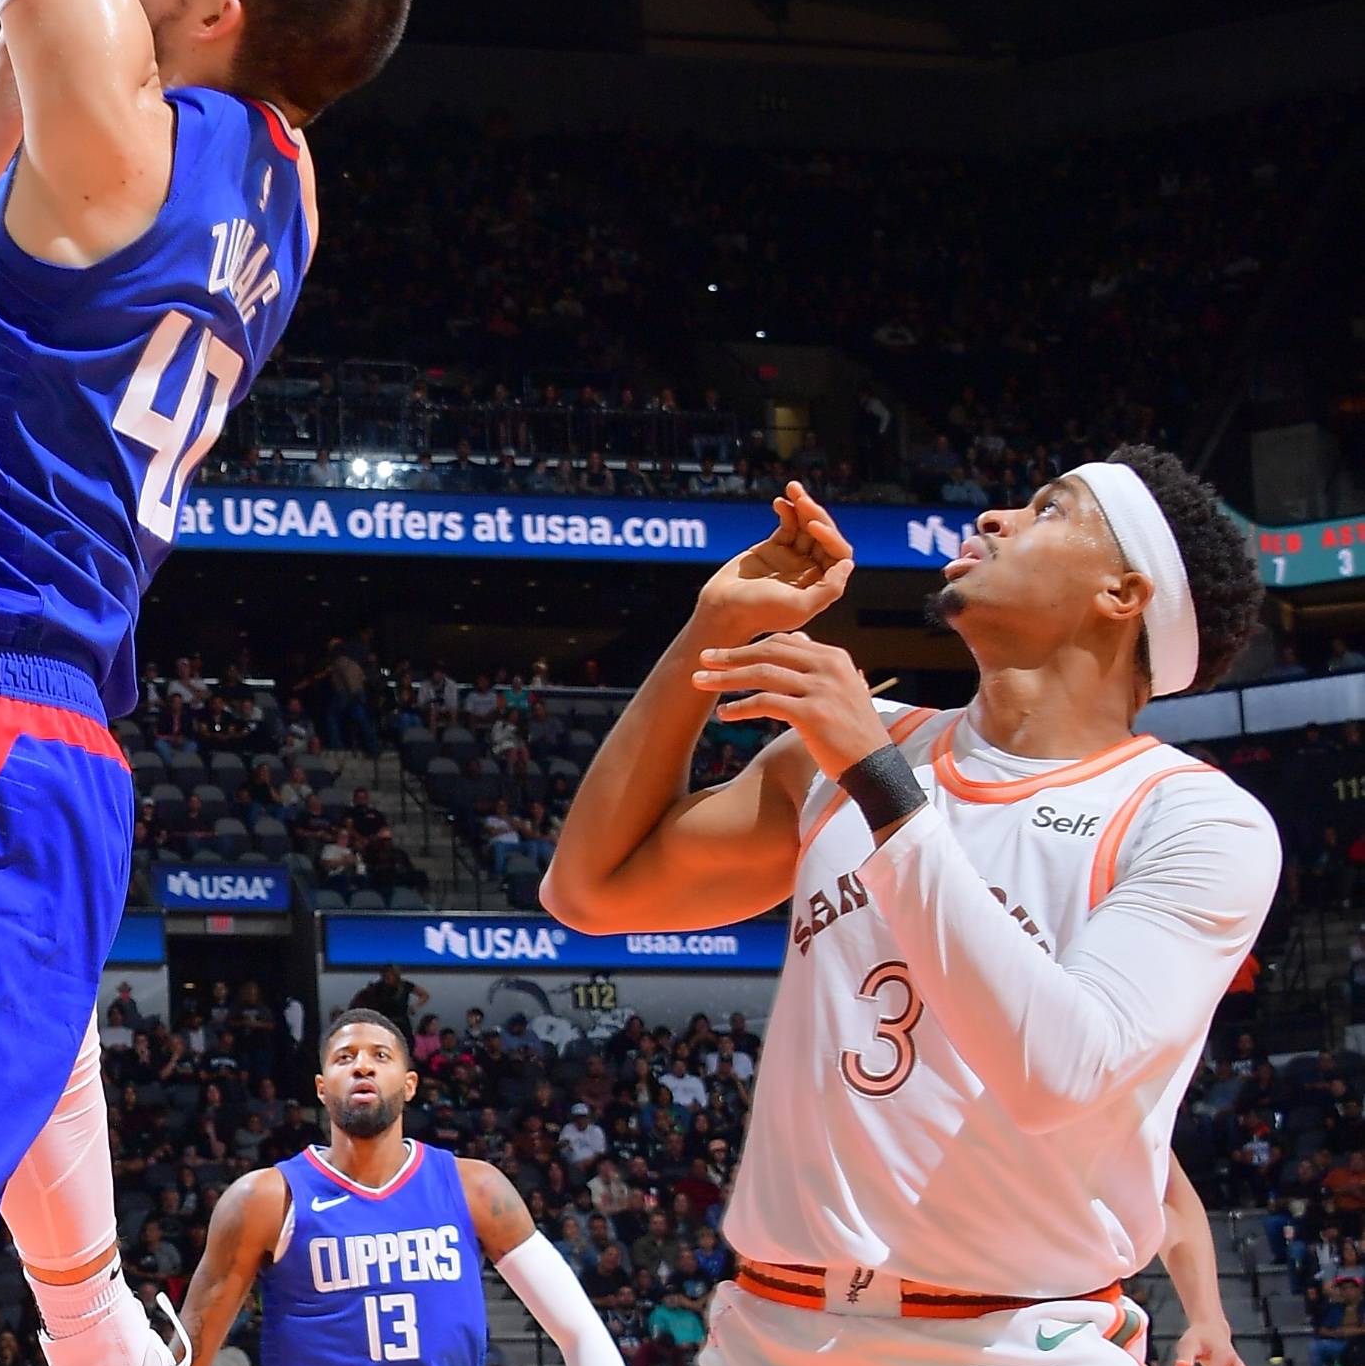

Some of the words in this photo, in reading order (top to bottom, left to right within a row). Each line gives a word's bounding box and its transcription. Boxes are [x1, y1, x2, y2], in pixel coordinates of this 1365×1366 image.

[113, 310, 244, 543] 40
[179, 498, 214, 534] at
[222, 498, 339, 537] USAA
[346, 502, 465, 542] offers
[473, 507, 514, 543] at
[522, 513, 707, 548] usaa.com
[1337, 548, 1353, 577] 3
[1032, 805, 1101, 837] Self.
[200, 875, 270, 901] USAA
[793, 871, 869, 957] SAN
[467, 927, 559, 960] USAA
[626, 934, 738, 955] usaa.com
[574, 986, 616, 1009] 112
[839, 960, 924, 1098] 3
[309, 1225, 462, 1294] CLIPPERS
[364, 1293, 421, 1362] 13
